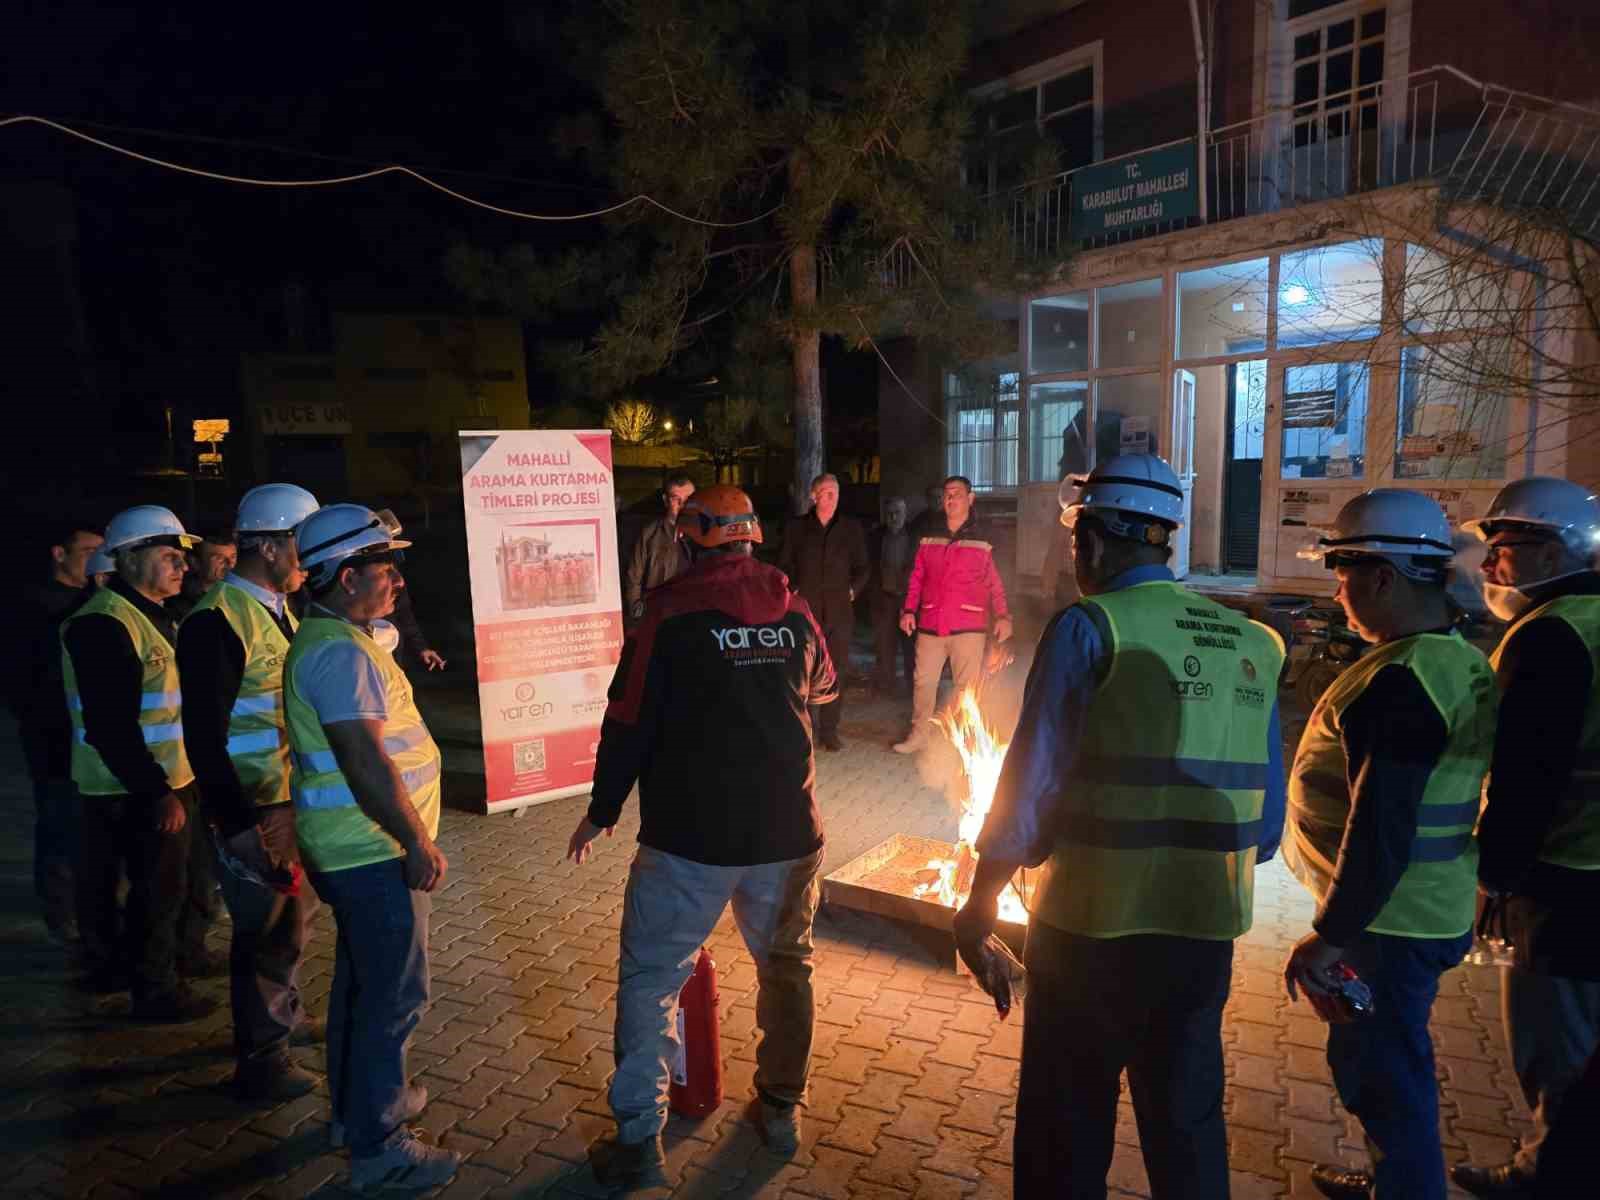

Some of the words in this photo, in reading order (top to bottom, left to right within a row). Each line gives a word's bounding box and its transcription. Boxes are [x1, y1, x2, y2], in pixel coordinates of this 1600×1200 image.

[1082, 183, 1135, 210] KARABULUT
[1136, 168, 1189, 198] MAHALLESİ
[1104, 200, 1163, 226] MUHTARLIĞI
[507, 451, 571, 467] MAHALLİ
[470, 473, 527, 489] ARAMA
[530, 472, 608, 487] KURTARMA
[481, 491, 539, 509] TİMLERİ
[542, 488, 600, 506] PROJESİ
